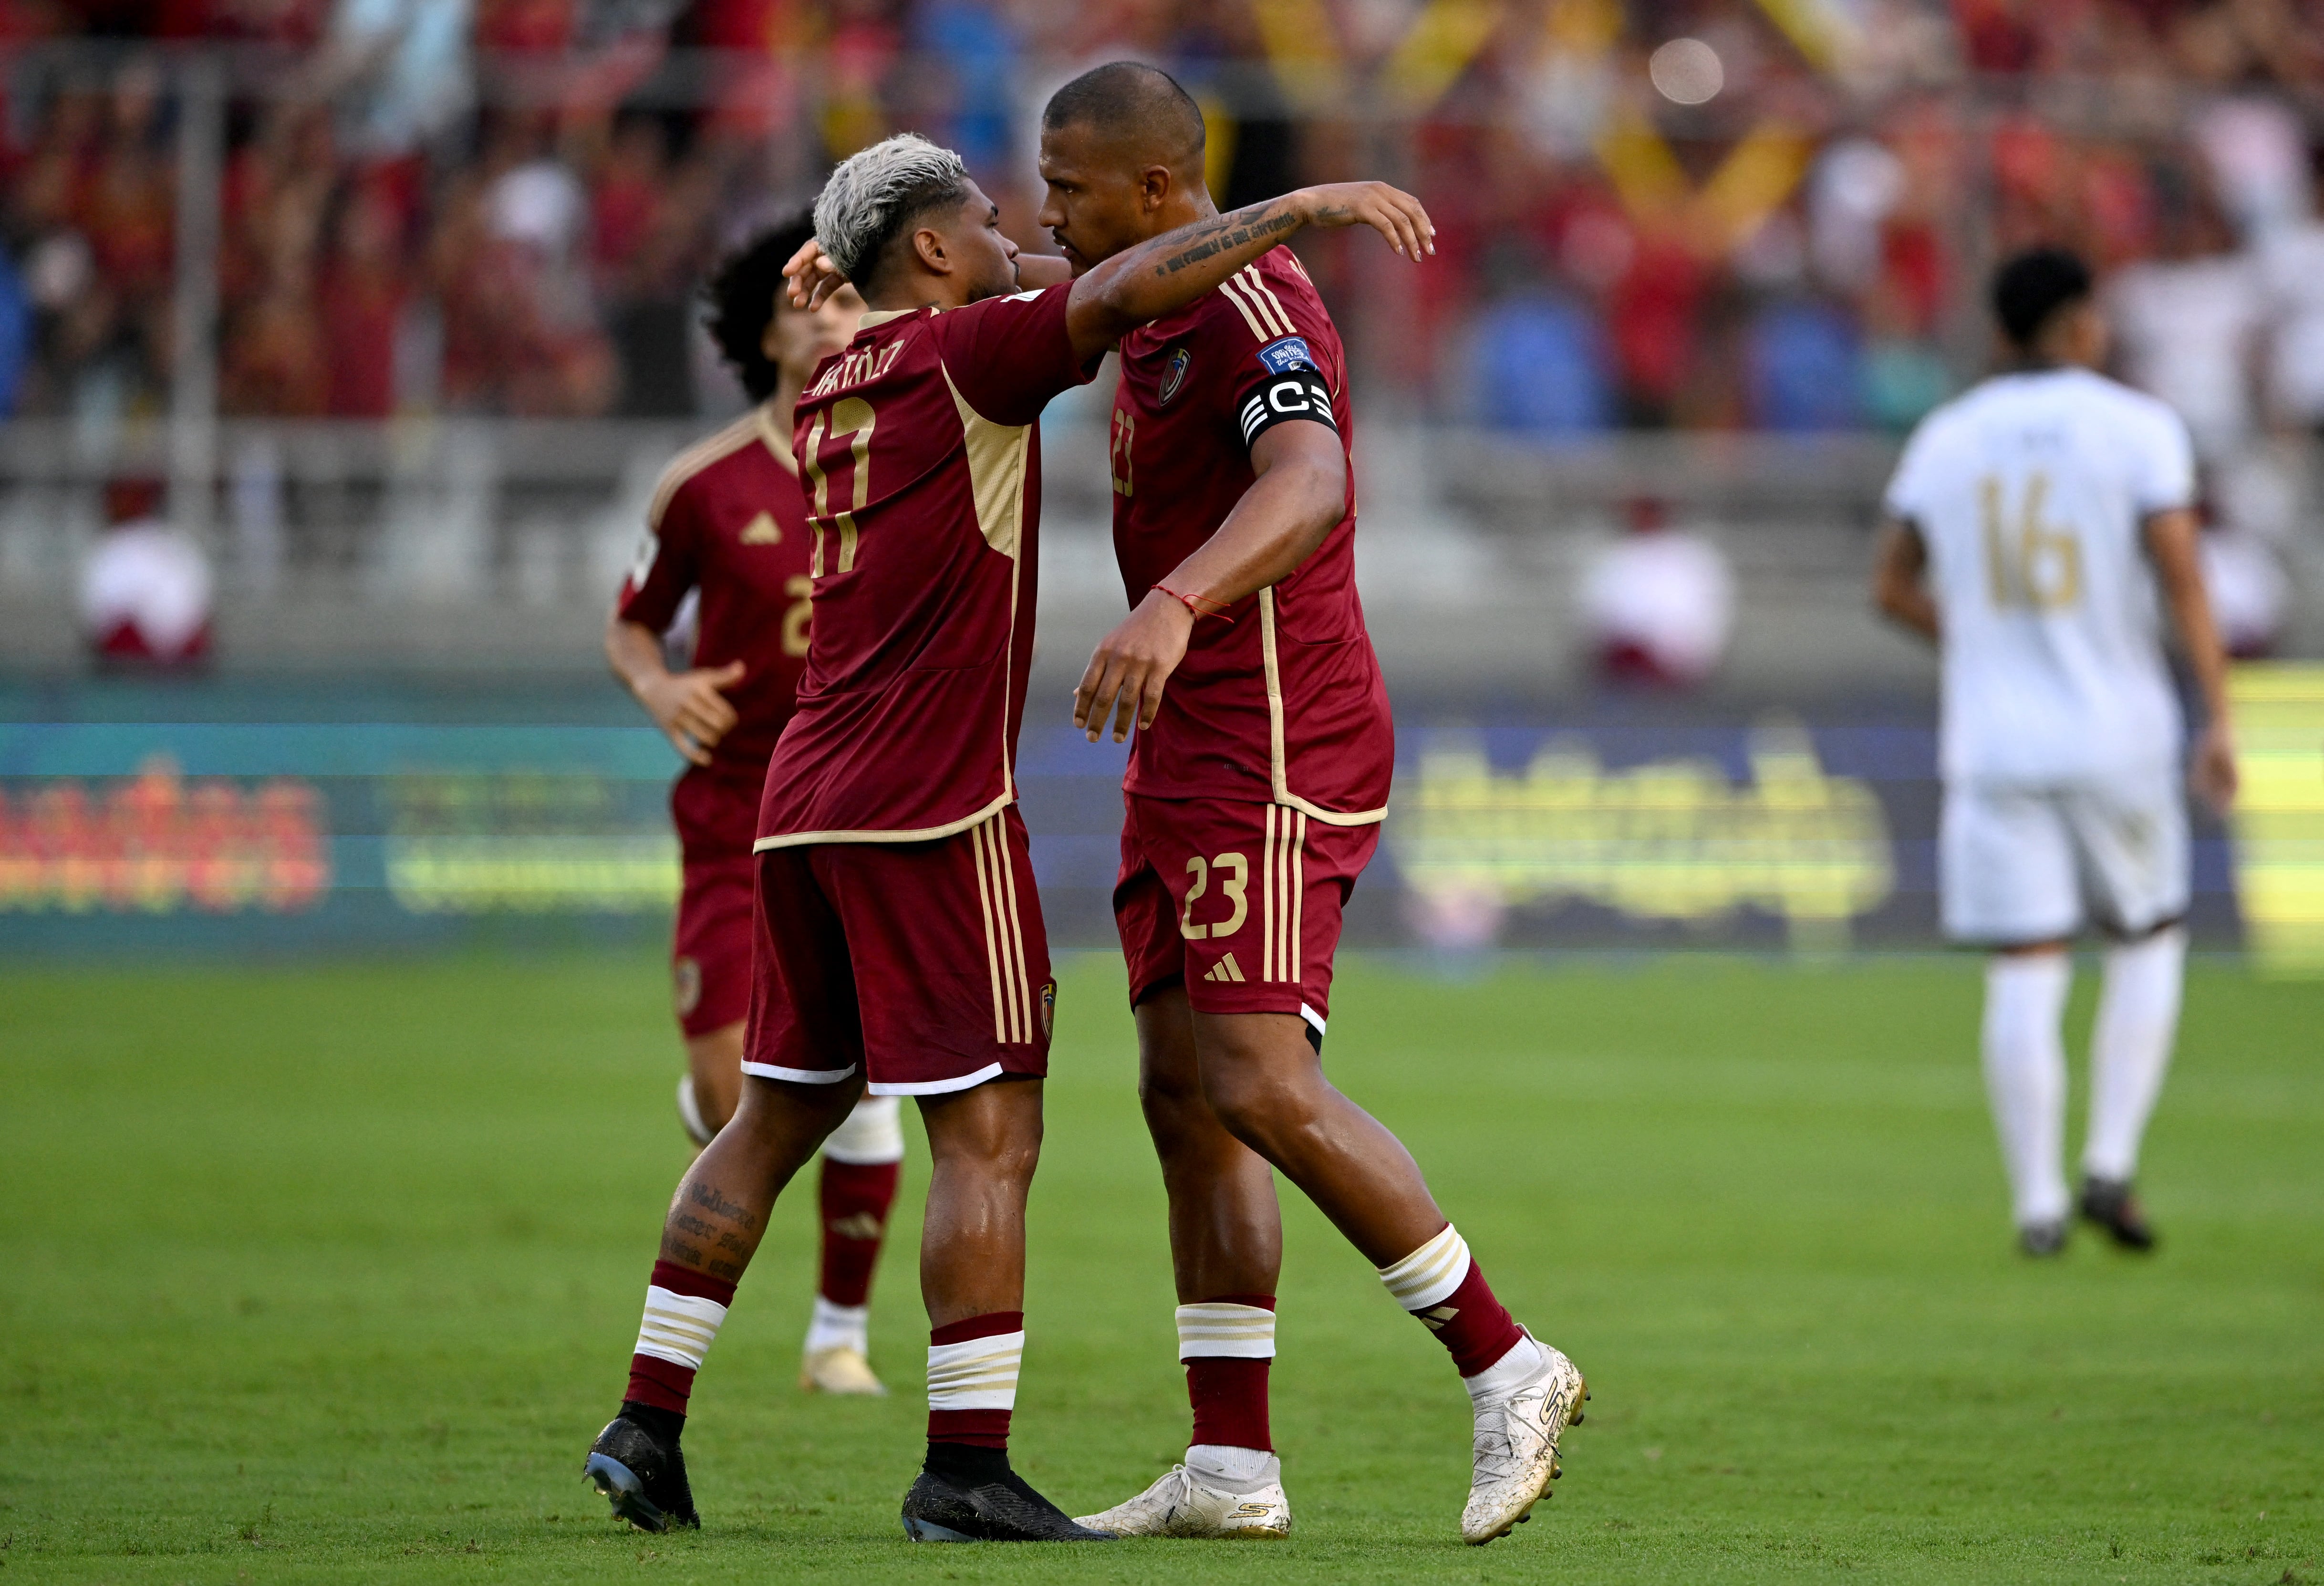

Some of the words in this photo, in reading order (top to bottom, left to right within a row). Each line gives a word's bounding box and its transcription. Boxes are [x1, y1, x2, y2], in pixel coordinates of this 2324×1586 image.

[1269, 381, 1310, 413] C
[805, 396, 876, 579] 17
[1978, 472, 2083, 608] 16
[1180, 852, 1248, 939] 23
